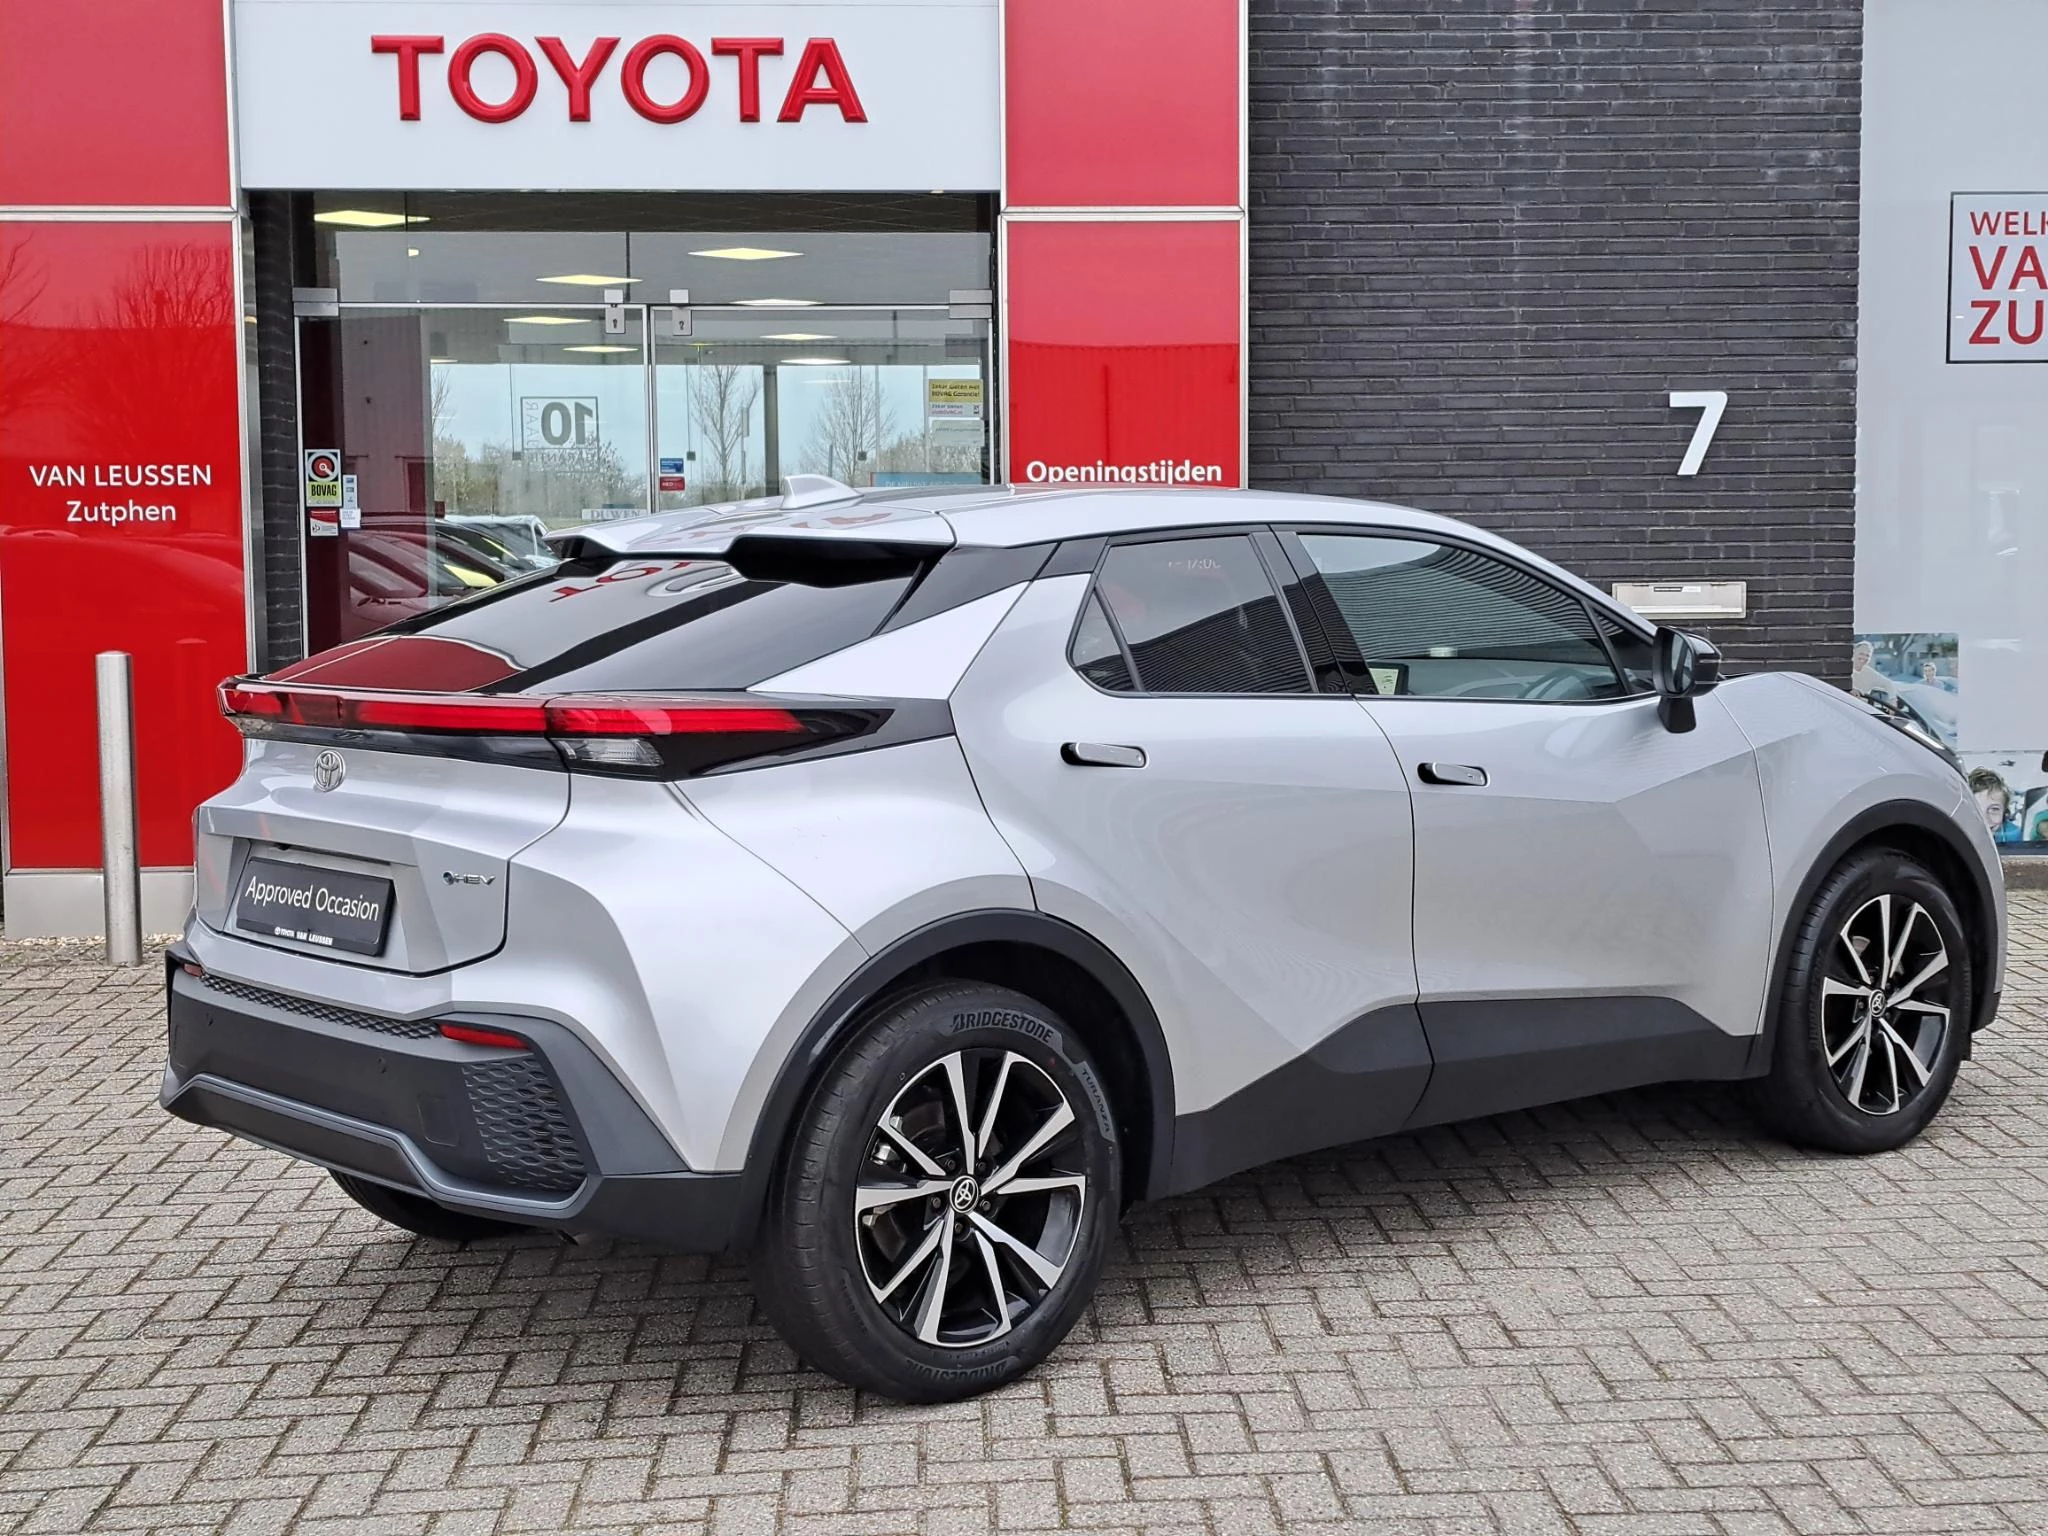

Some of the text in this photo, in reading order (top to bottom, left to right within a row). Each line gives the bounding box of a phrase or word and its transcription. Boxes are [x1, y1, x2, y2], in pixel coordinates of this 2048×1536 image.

[371, 32, 868, 124] TOYOTA
[1668, 391, 1729, 476] 7
[29, 464, 212, 487] VAN LEUSSEN
[1026, 460, 1223, 485] Openingstijden
[311, 484, 337, 497] BOVAG
[66, 499, 177, 527] Zutphen
[245, 876, 379, 921] Approved Occasion
[951, 1011, 1054, 1043] BRIDGESTONE
[1081, 1068, 1110, 1133] TURANZA
